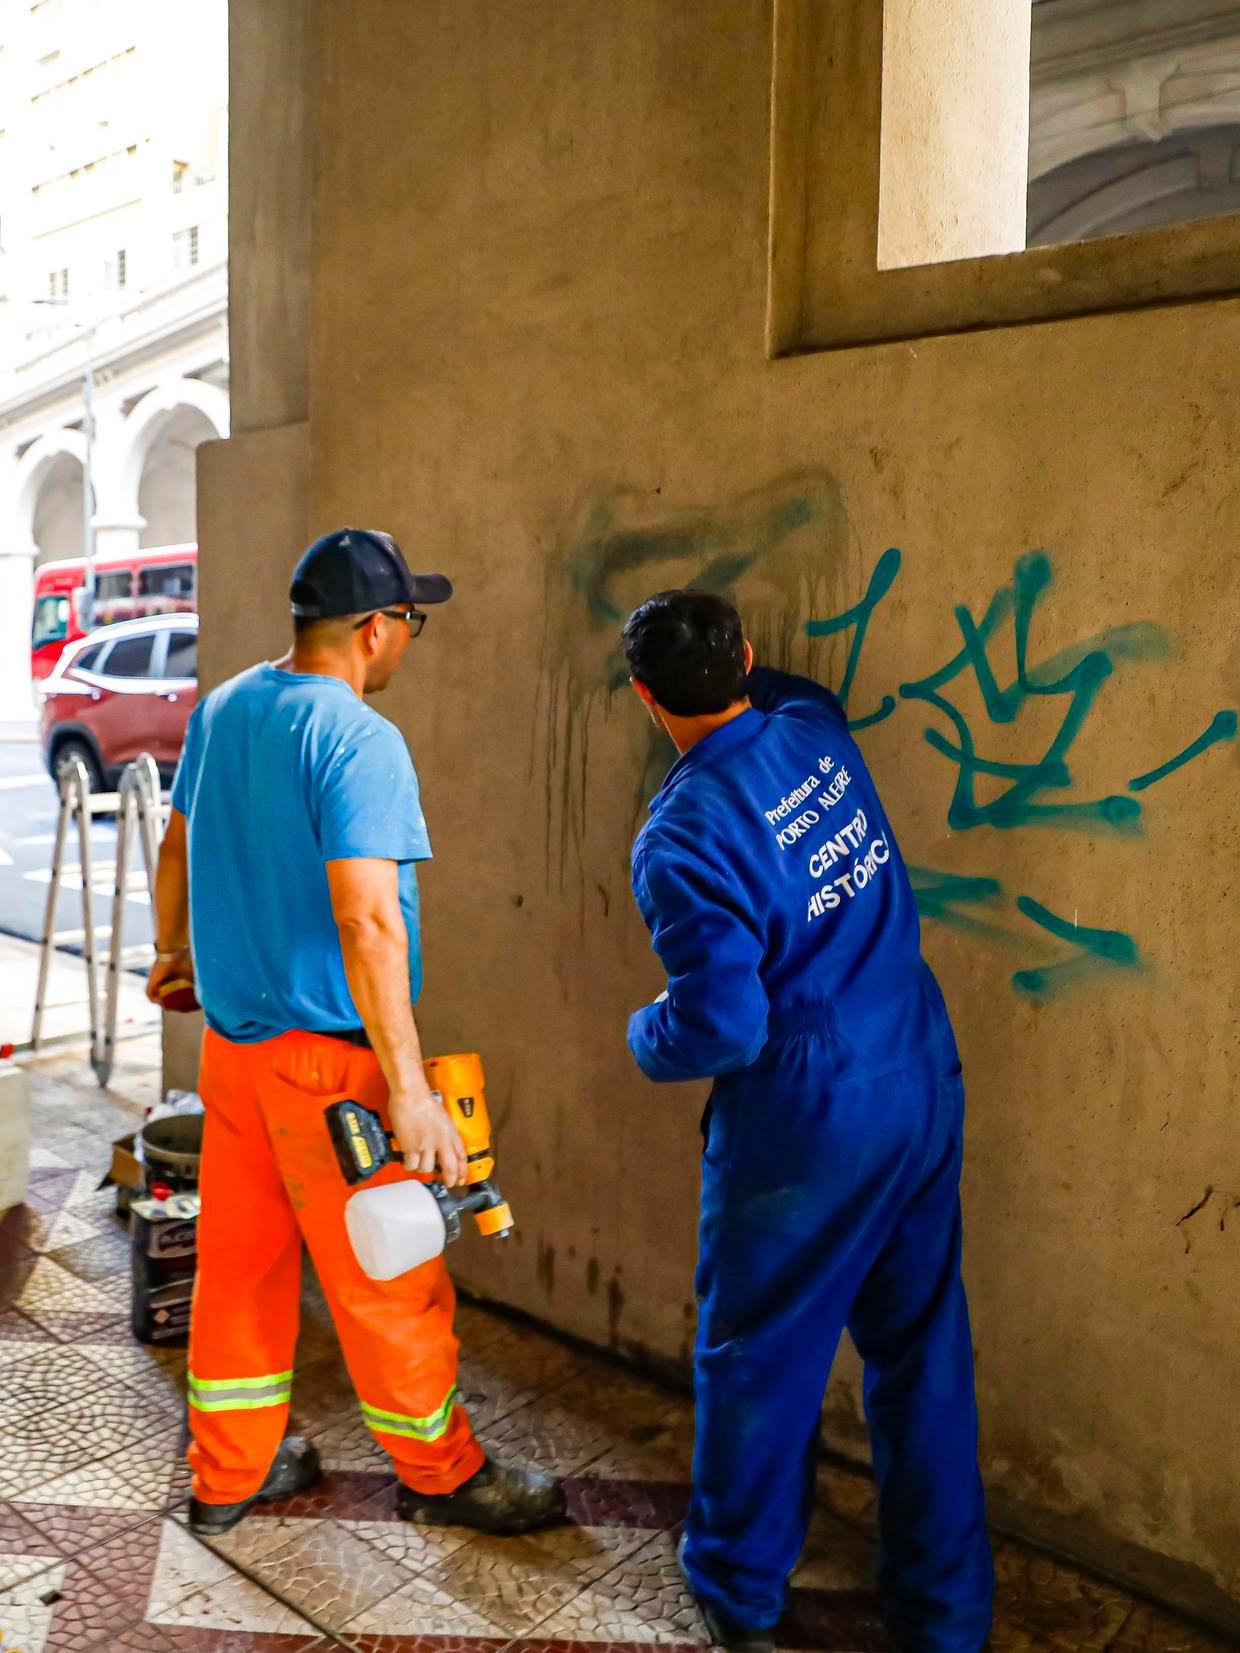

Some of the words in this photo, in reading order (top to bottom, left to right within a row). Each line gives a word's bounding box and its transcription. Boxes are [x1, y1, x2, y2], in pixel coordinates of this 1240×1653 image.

[765, 775, 820, 825] Prefeitura
[818, 755, 834, 774] de
[776, 810, 820, 850] PORTO
[818, 765, 851, 811] ALEGRE
[808, 830, 890, 922] HISTÓRIC
